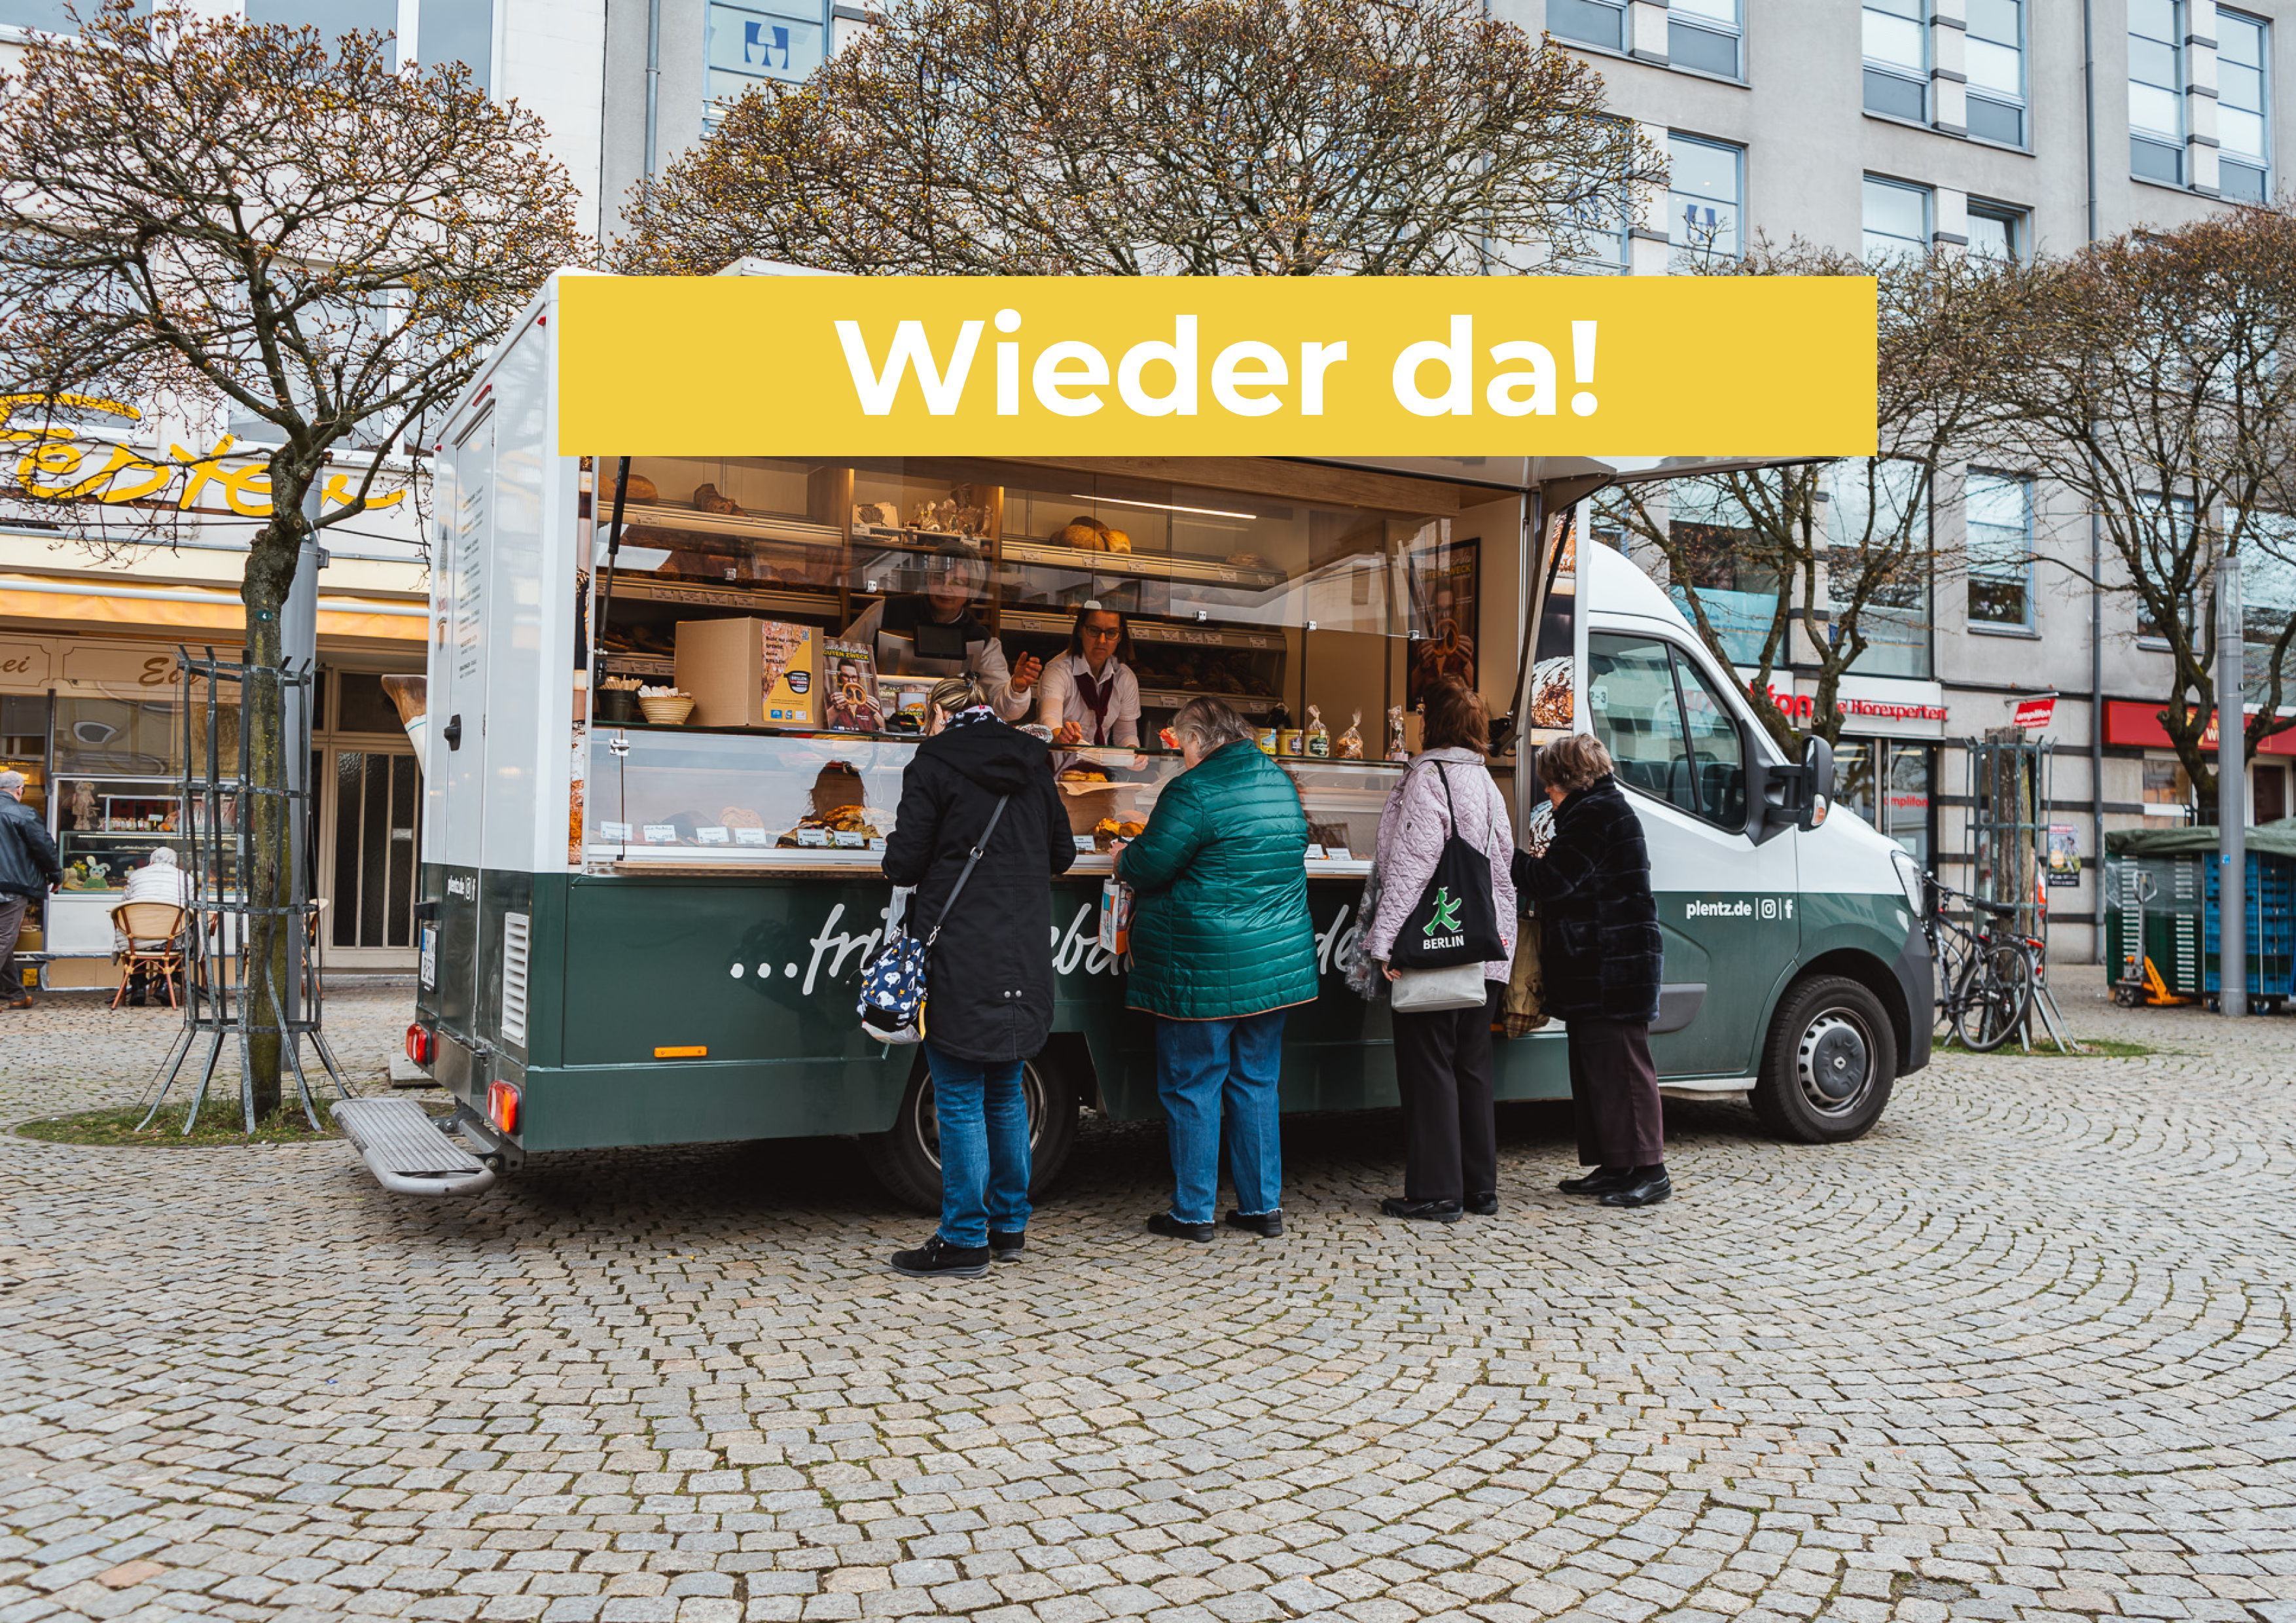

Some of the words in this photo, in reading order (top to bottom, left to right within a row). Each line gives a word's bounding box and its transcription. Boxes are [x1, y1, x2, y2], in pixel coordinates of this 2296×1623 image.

[1852, 699, 1947, 722] Hörexperten
[1686, 900, 1752, 919] plentz.de
[1423, 935, 1465, 950] BERLIN
